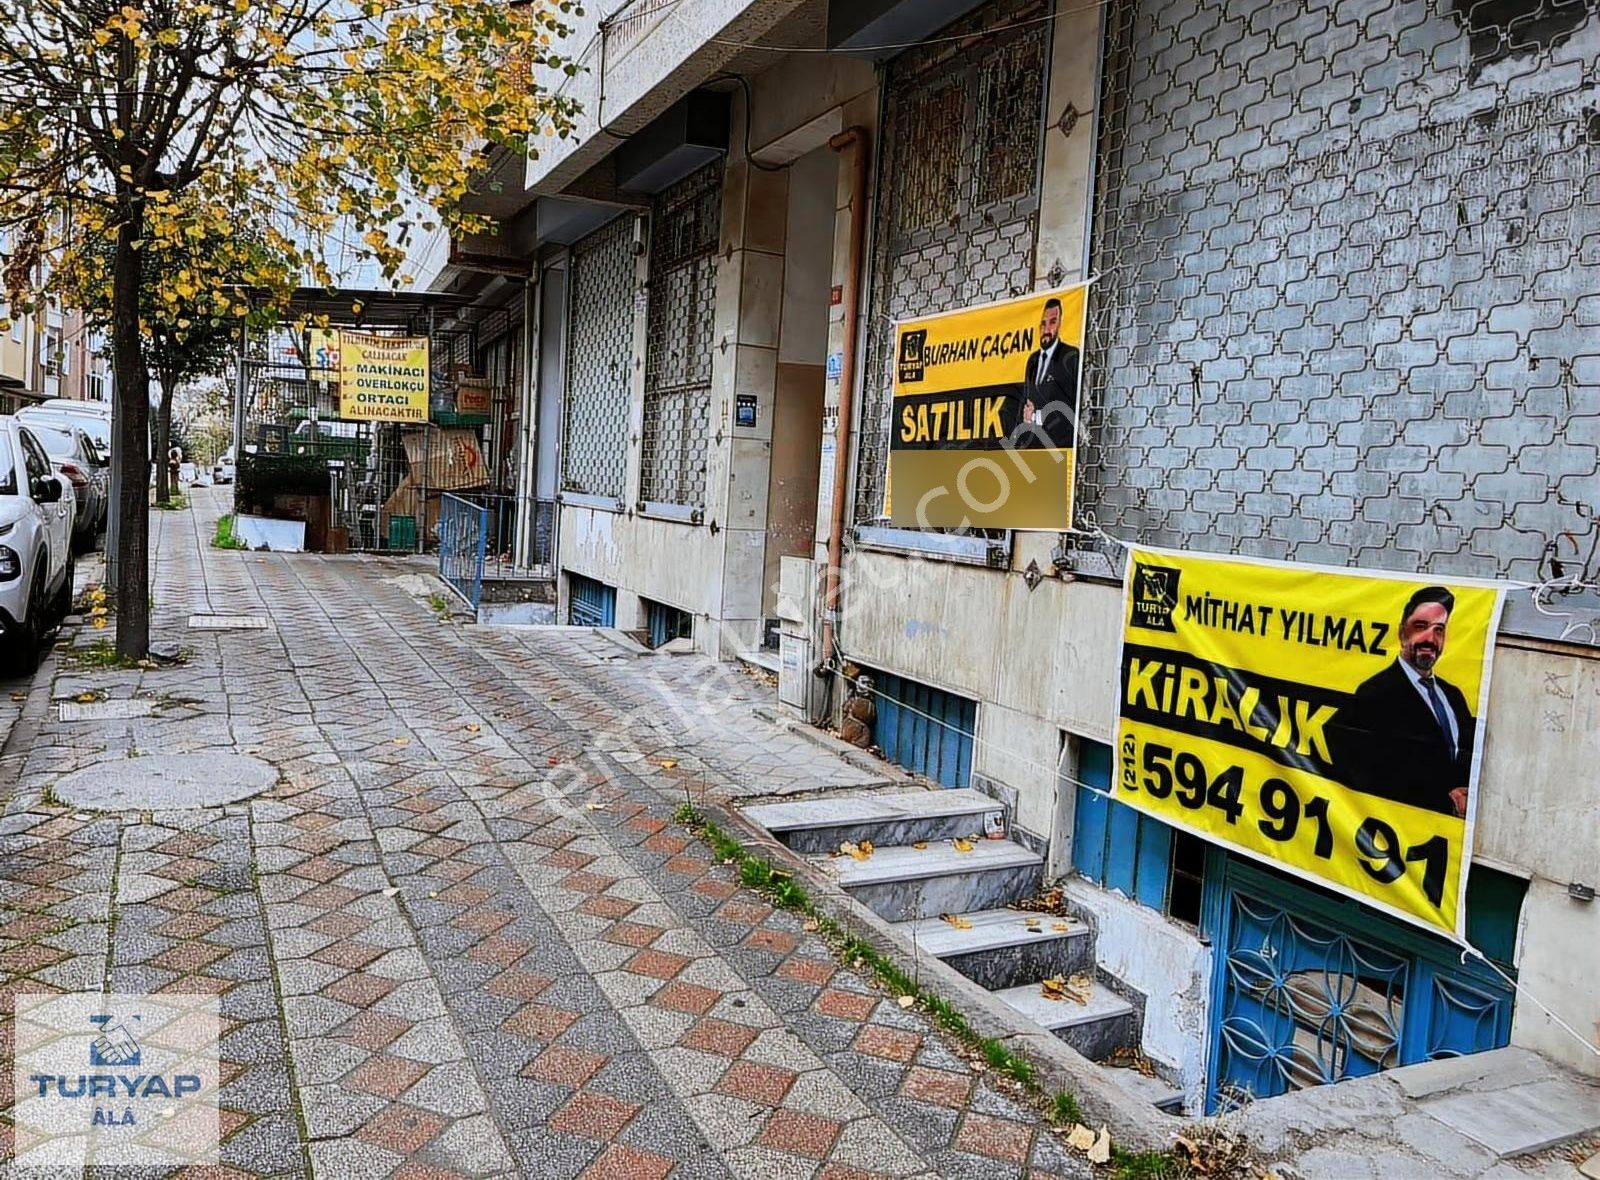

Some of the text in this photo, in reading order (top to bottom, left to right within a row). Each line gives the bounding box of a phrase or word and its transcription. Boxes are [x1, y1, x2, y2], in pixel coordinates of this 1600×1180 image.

[924, 327, 1034, 368] BURHAN ÇAÇAN
[356, 364, 425, 377] MAKİNACI
[356, 378, 425, 392] OVERLOKÇU
[349, 405, 423, 418] ALINACAKTIR
[356, 393, 409, 405] ORTACI
[900, 395, 1007, 443] SATILIK
[1183, 591, 1390, 657] MİTHAT YILMAZ
[1126, 657, 1339, 765] KİRALIK
[1122, 733, 1137, 791] (212)
[1142, 742, 1449, 909] 594 91 91
